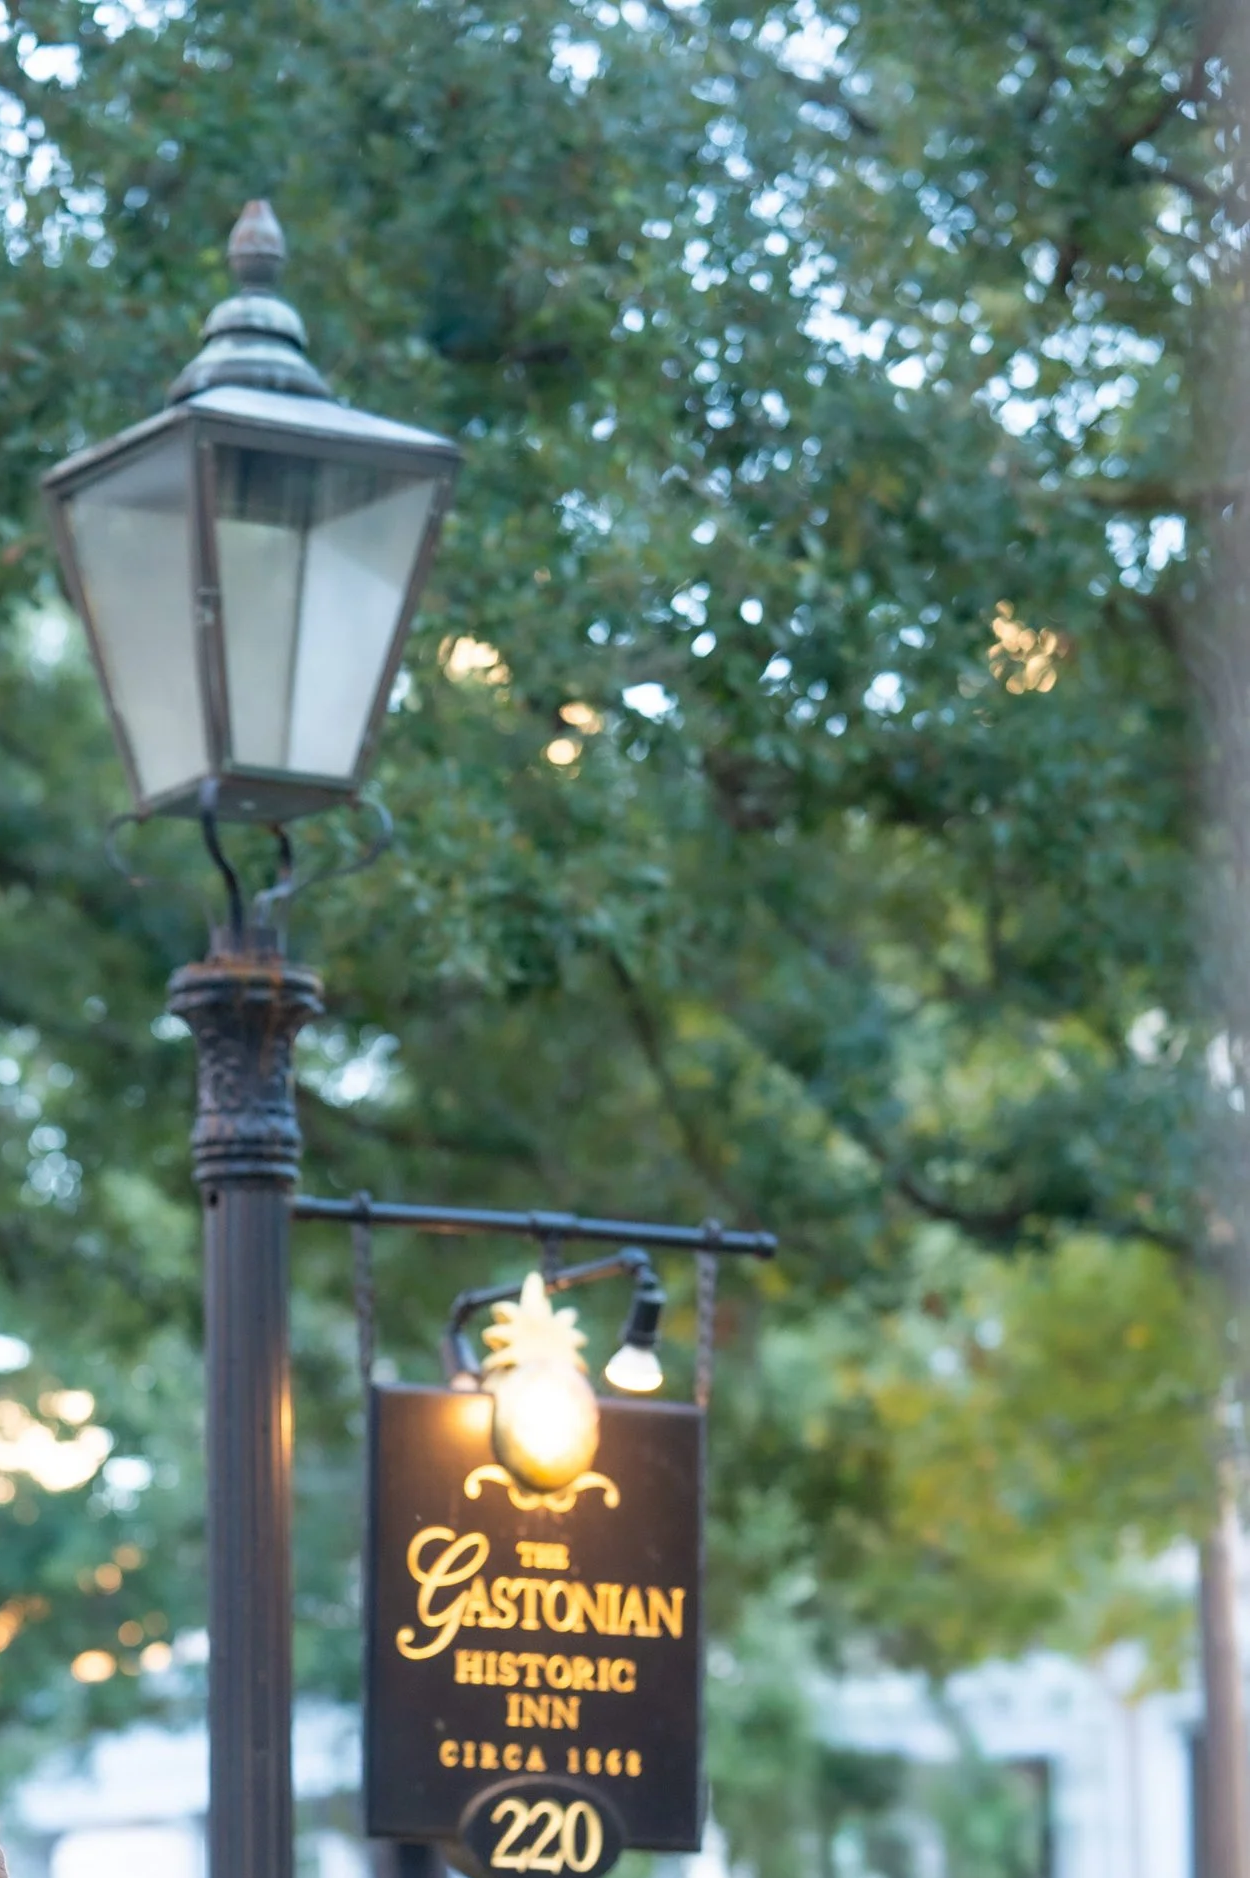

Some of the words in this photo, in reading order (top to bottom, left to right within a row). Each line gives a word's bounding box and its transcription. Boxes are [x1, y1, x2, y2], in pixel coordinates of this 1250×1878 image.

[515, 1541, 570, 1570] THE
[396, 1526, 686, 1660] GASTONIAN
[454, 1649, 637, 1693] HISTORIC
[505, 1692, 581, 1730] INN
[439, 1740, 547, 1772] CIRCA
[567, 1746, 643, 1777] 1868
[490, 1796, 604, 1874] 220
